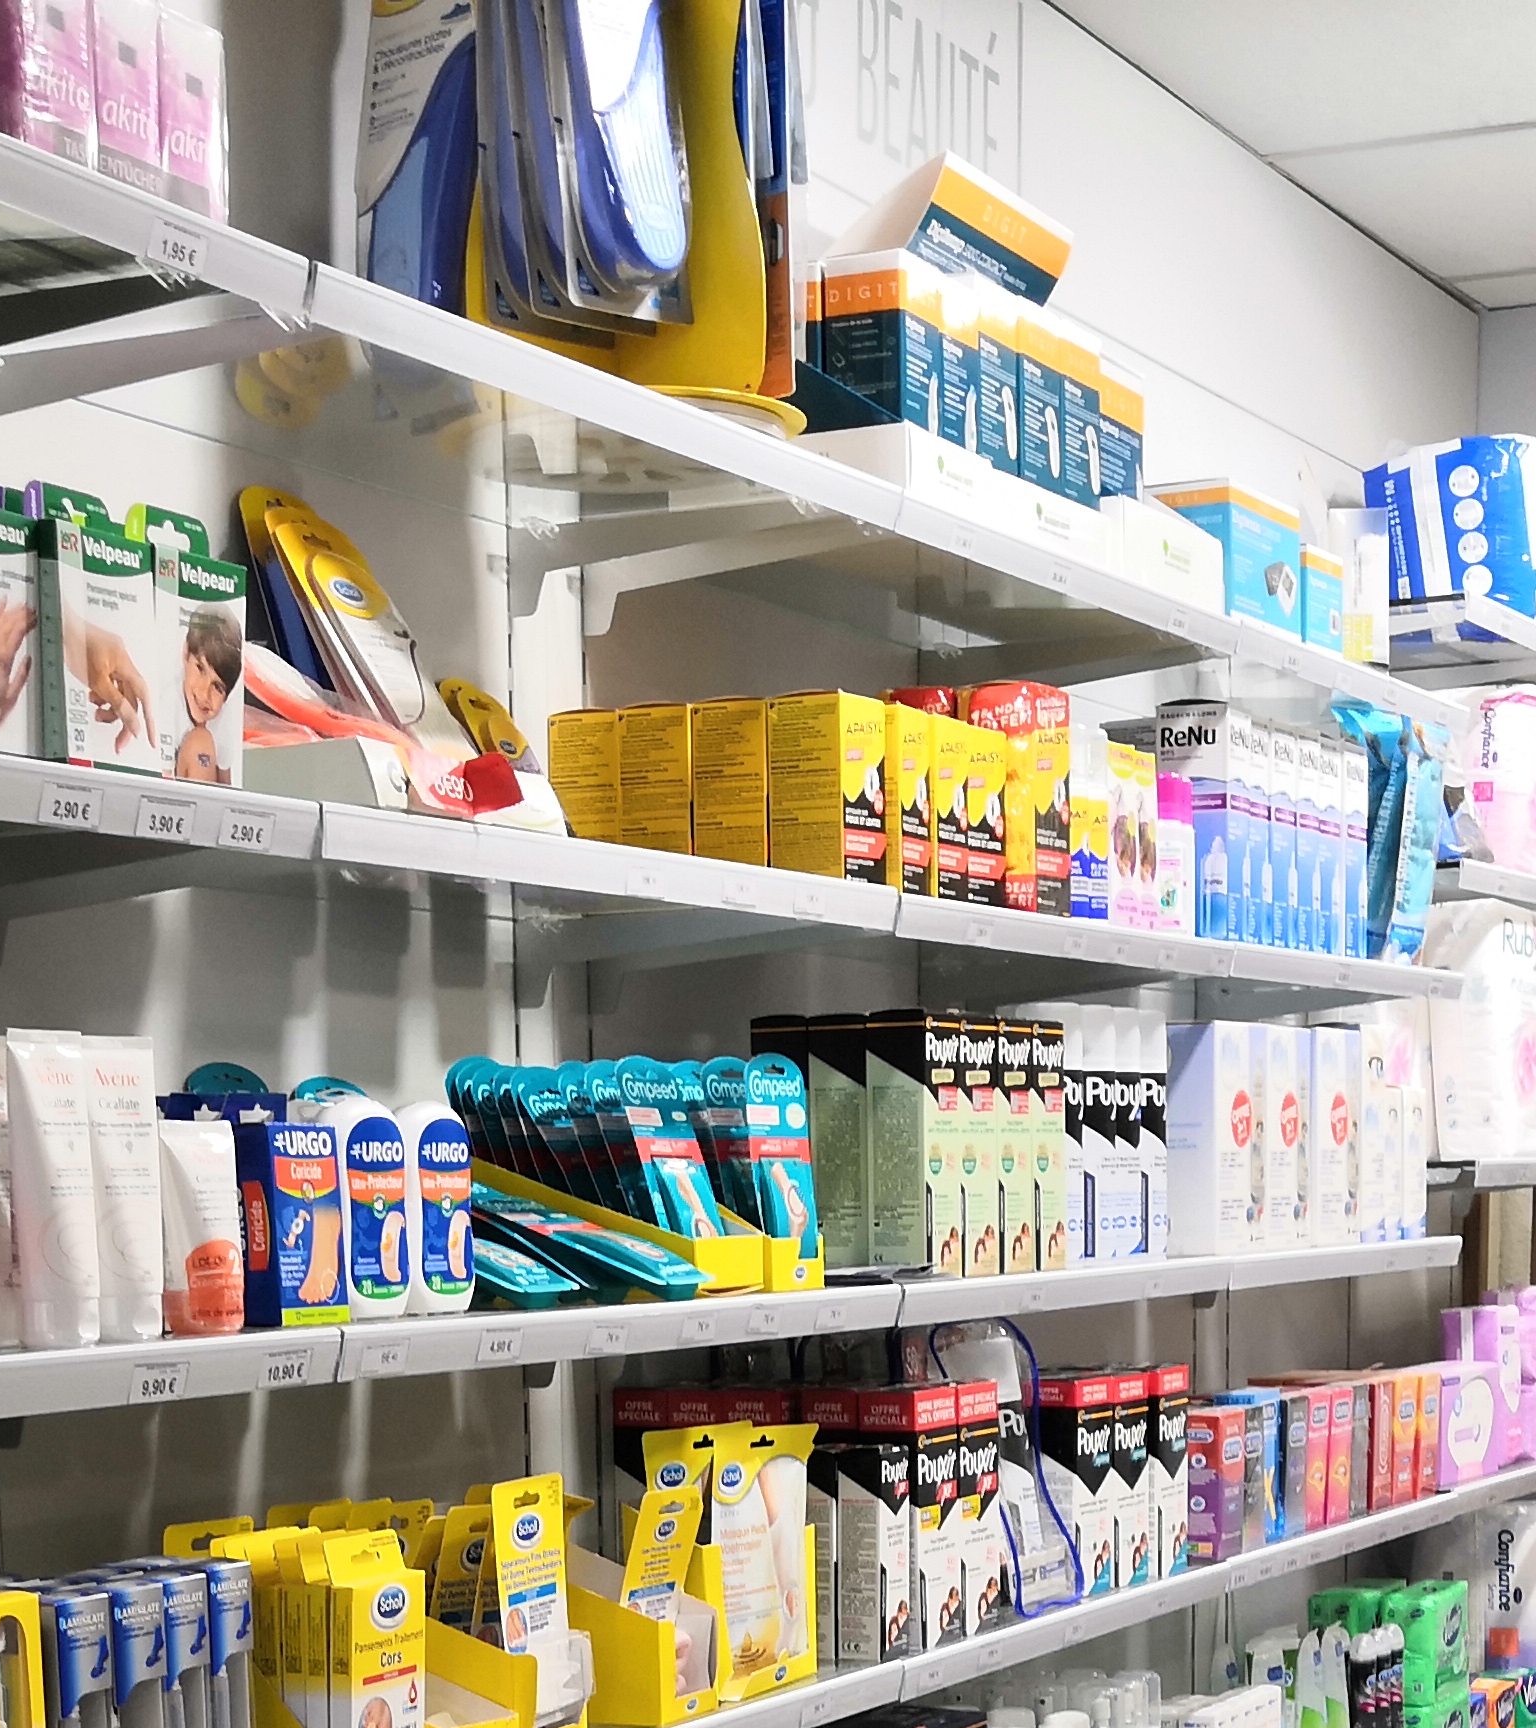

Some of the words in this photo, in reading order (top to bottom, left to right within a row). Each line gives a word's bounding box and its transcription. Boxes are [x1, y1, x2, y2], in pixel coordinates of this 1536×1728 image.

[982, 204, 1027, 243] DIGIT
[829, 282, 899, 304] DIGIT
[82, 535, 140, 570] Velpeau
[179, 561, 236, 594] Velpeau
[846, 720, 884, 737] APAISYL
[1160, 725, 1217, 748] ReNu
[148, 814, 174, 833] 3,90
[175, 817, 184, 834] €
[925, 1034, 960, 1068] Pouxit
[960, 1035, 996, 1070] Pouxit
[998, 1037, 1032, 1068] Pouxit
[1033, 1038, 1064, 1069] Pouxit
[93, 1067, 140, 1088] Avène
[623, 1074, 678, 1103] Compeed
[749, 1074, 805, 1103] Compeed
[283, 1132, 332, 1158] URGO
[361, 1141, 403, 1164] URGO
[431, 1141, 469, 1164] URGO
[290, 1162, 323, 1183] Coricide
[252, 1198, 266, 1253] Coricide
[266, 1364, 293, 1383] 10,90
[294, 1361, 305, 1379] €
[140, 1377, 166, 1398] 9,90
[166, 1376, 177, 1394] €
[1077, 1428, 1111, 1458] Pouxit
[916, 1448, 957, 1497] Pouxit
[960, 1442, 1000, 1486] Pouxit
[515, 1518, 539, 1541] Scholl
[1498, 1530, 1516, 1613] Confiance
[378, 1592, 406, 1615] Scholl
[380, 1650, 403, 1668] Cors
